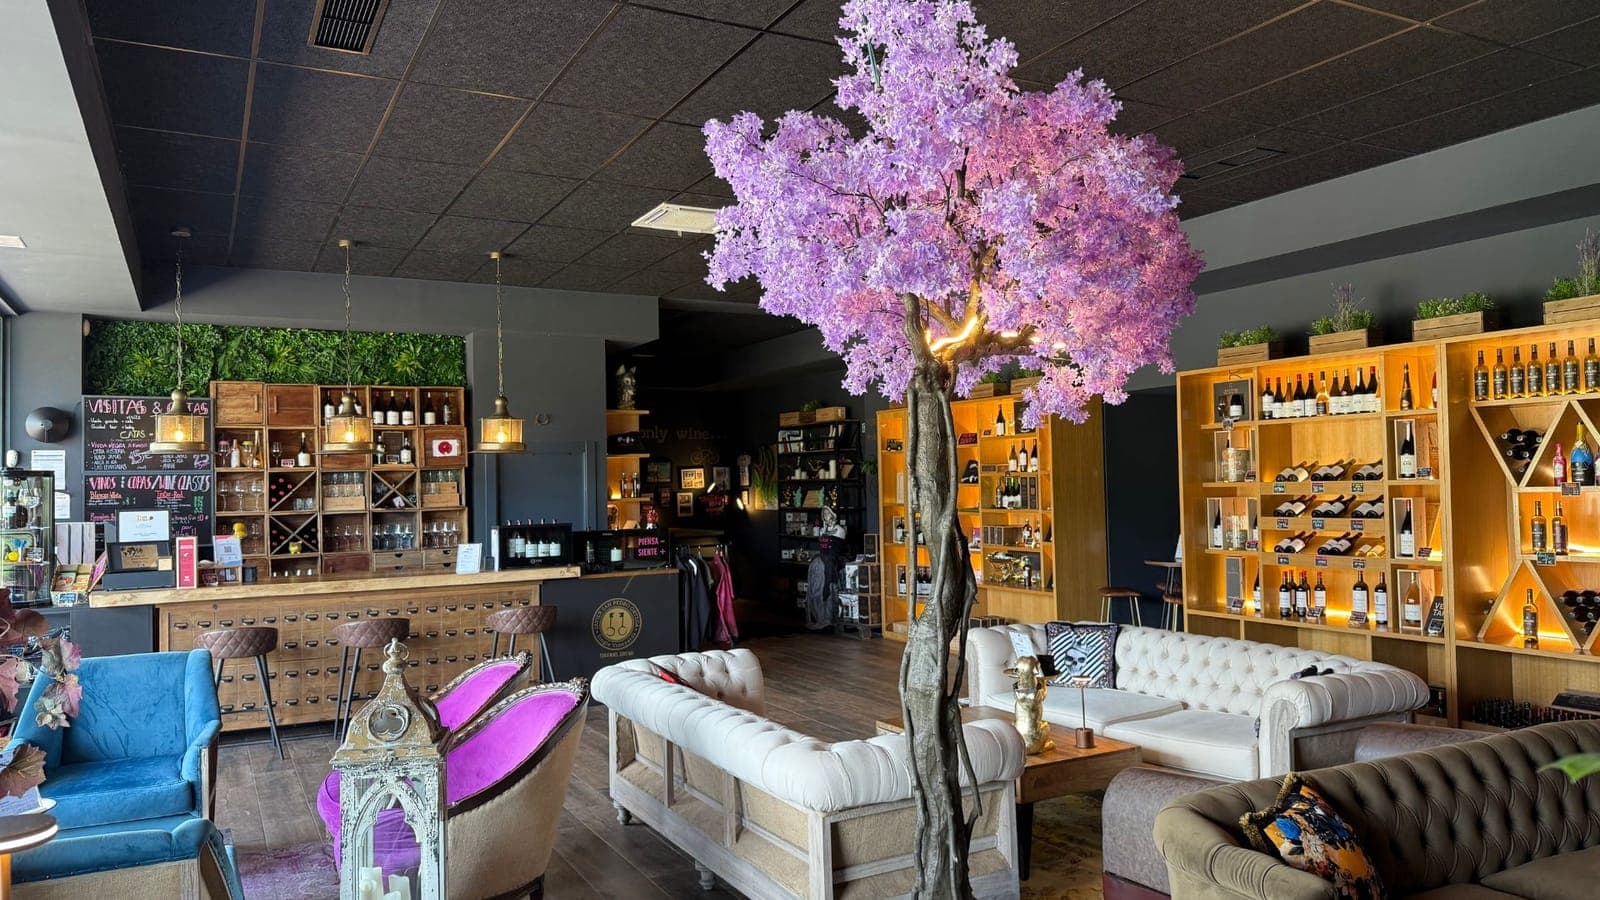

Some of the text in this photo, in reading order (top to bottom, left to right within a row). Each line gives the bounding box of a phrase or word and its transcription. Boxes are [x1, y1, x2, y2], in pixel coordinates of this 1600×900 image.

[88, 399, 147, 415] VISITAS
[152, 401, 162, 414] &
[89, 476, 116, 490] VINOS
[638, 537, 659, 546] PIENSA
[638, 547, 658, 557] SIENTE
